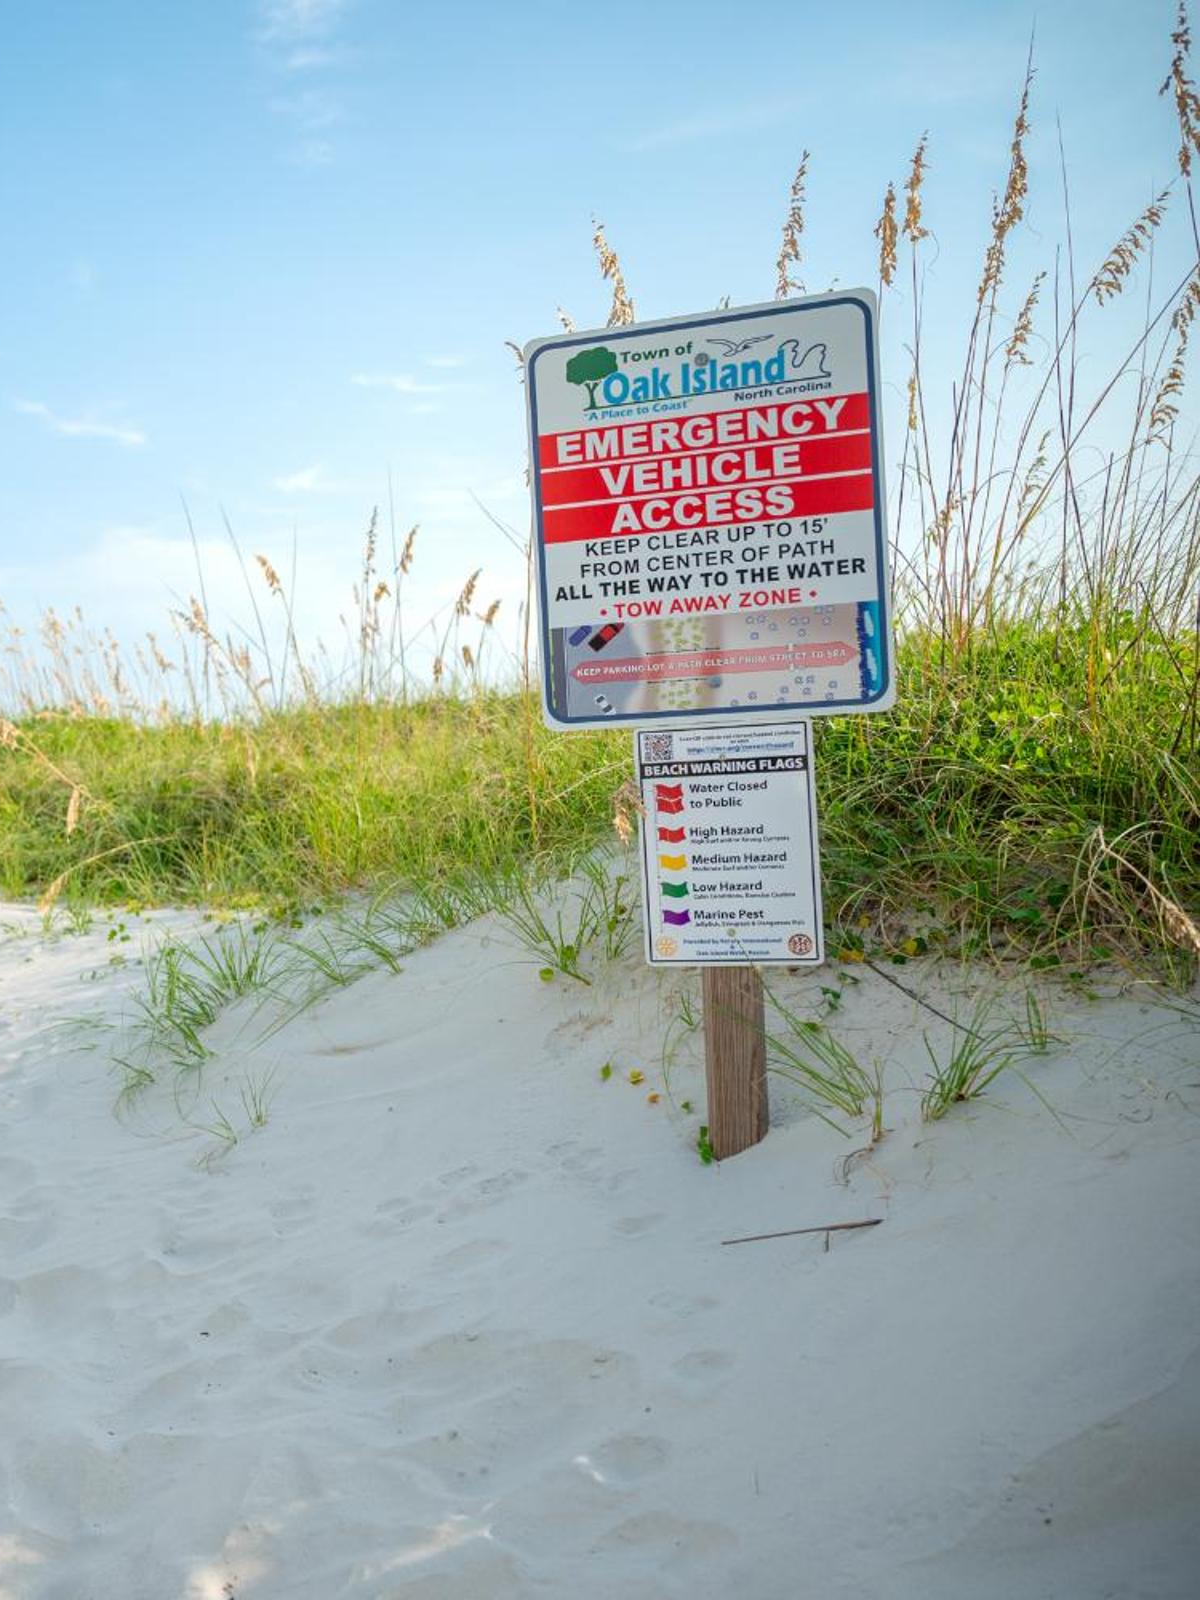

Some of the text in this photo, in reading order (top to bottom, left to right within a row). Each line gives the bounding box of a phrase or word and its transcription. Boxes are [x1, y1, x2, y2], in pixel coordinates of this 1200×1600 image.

[620, 341, 693, 364] Town of
[603, 347, 785, 405] Oak Island
[734, 380, 832, 402] North Carolina
[601, 407, 633, 419] Place
[636, 404, 649, 414] to
[556, 397, 848, 464] EMERGENCY
[600, 444, 801, 496] VEHICLE
[610, 488, 794, 534] ACCESS
[585, 538, 640, 557] KEEP
[647, 530, 720, 551] CLEAR
[727, 525, 755, 543] UP
[762, 522, 792, 538] TO
[581, 539, 835, 578] FROM CENTER OF PATH
[555, 558, 866, 602] ALL THE WAY TO THE WATER
[613, 588, 801, 619] TOW AWAY ZONE
[576, 666, 601, 678] KEEP
[604, 662, 645, 675] PARKING
[647, 662, 667, 672] LOT
[705, 656, 737, 667] CLEAR
[812, 649, 826, 659] TO
[644, 757, 803, 776] BEACH WARNING FLAGS
[689, 780, 768, 793] Water Closed
[690, 797, 743, 808] to Public
[690, 825, 764, 838] High Hazard
[692, 852, 787, 864] Medium Hazard
[693, 882, 762, 892] Low Hazard
[694, 910, 764, 919] Marine Pest
